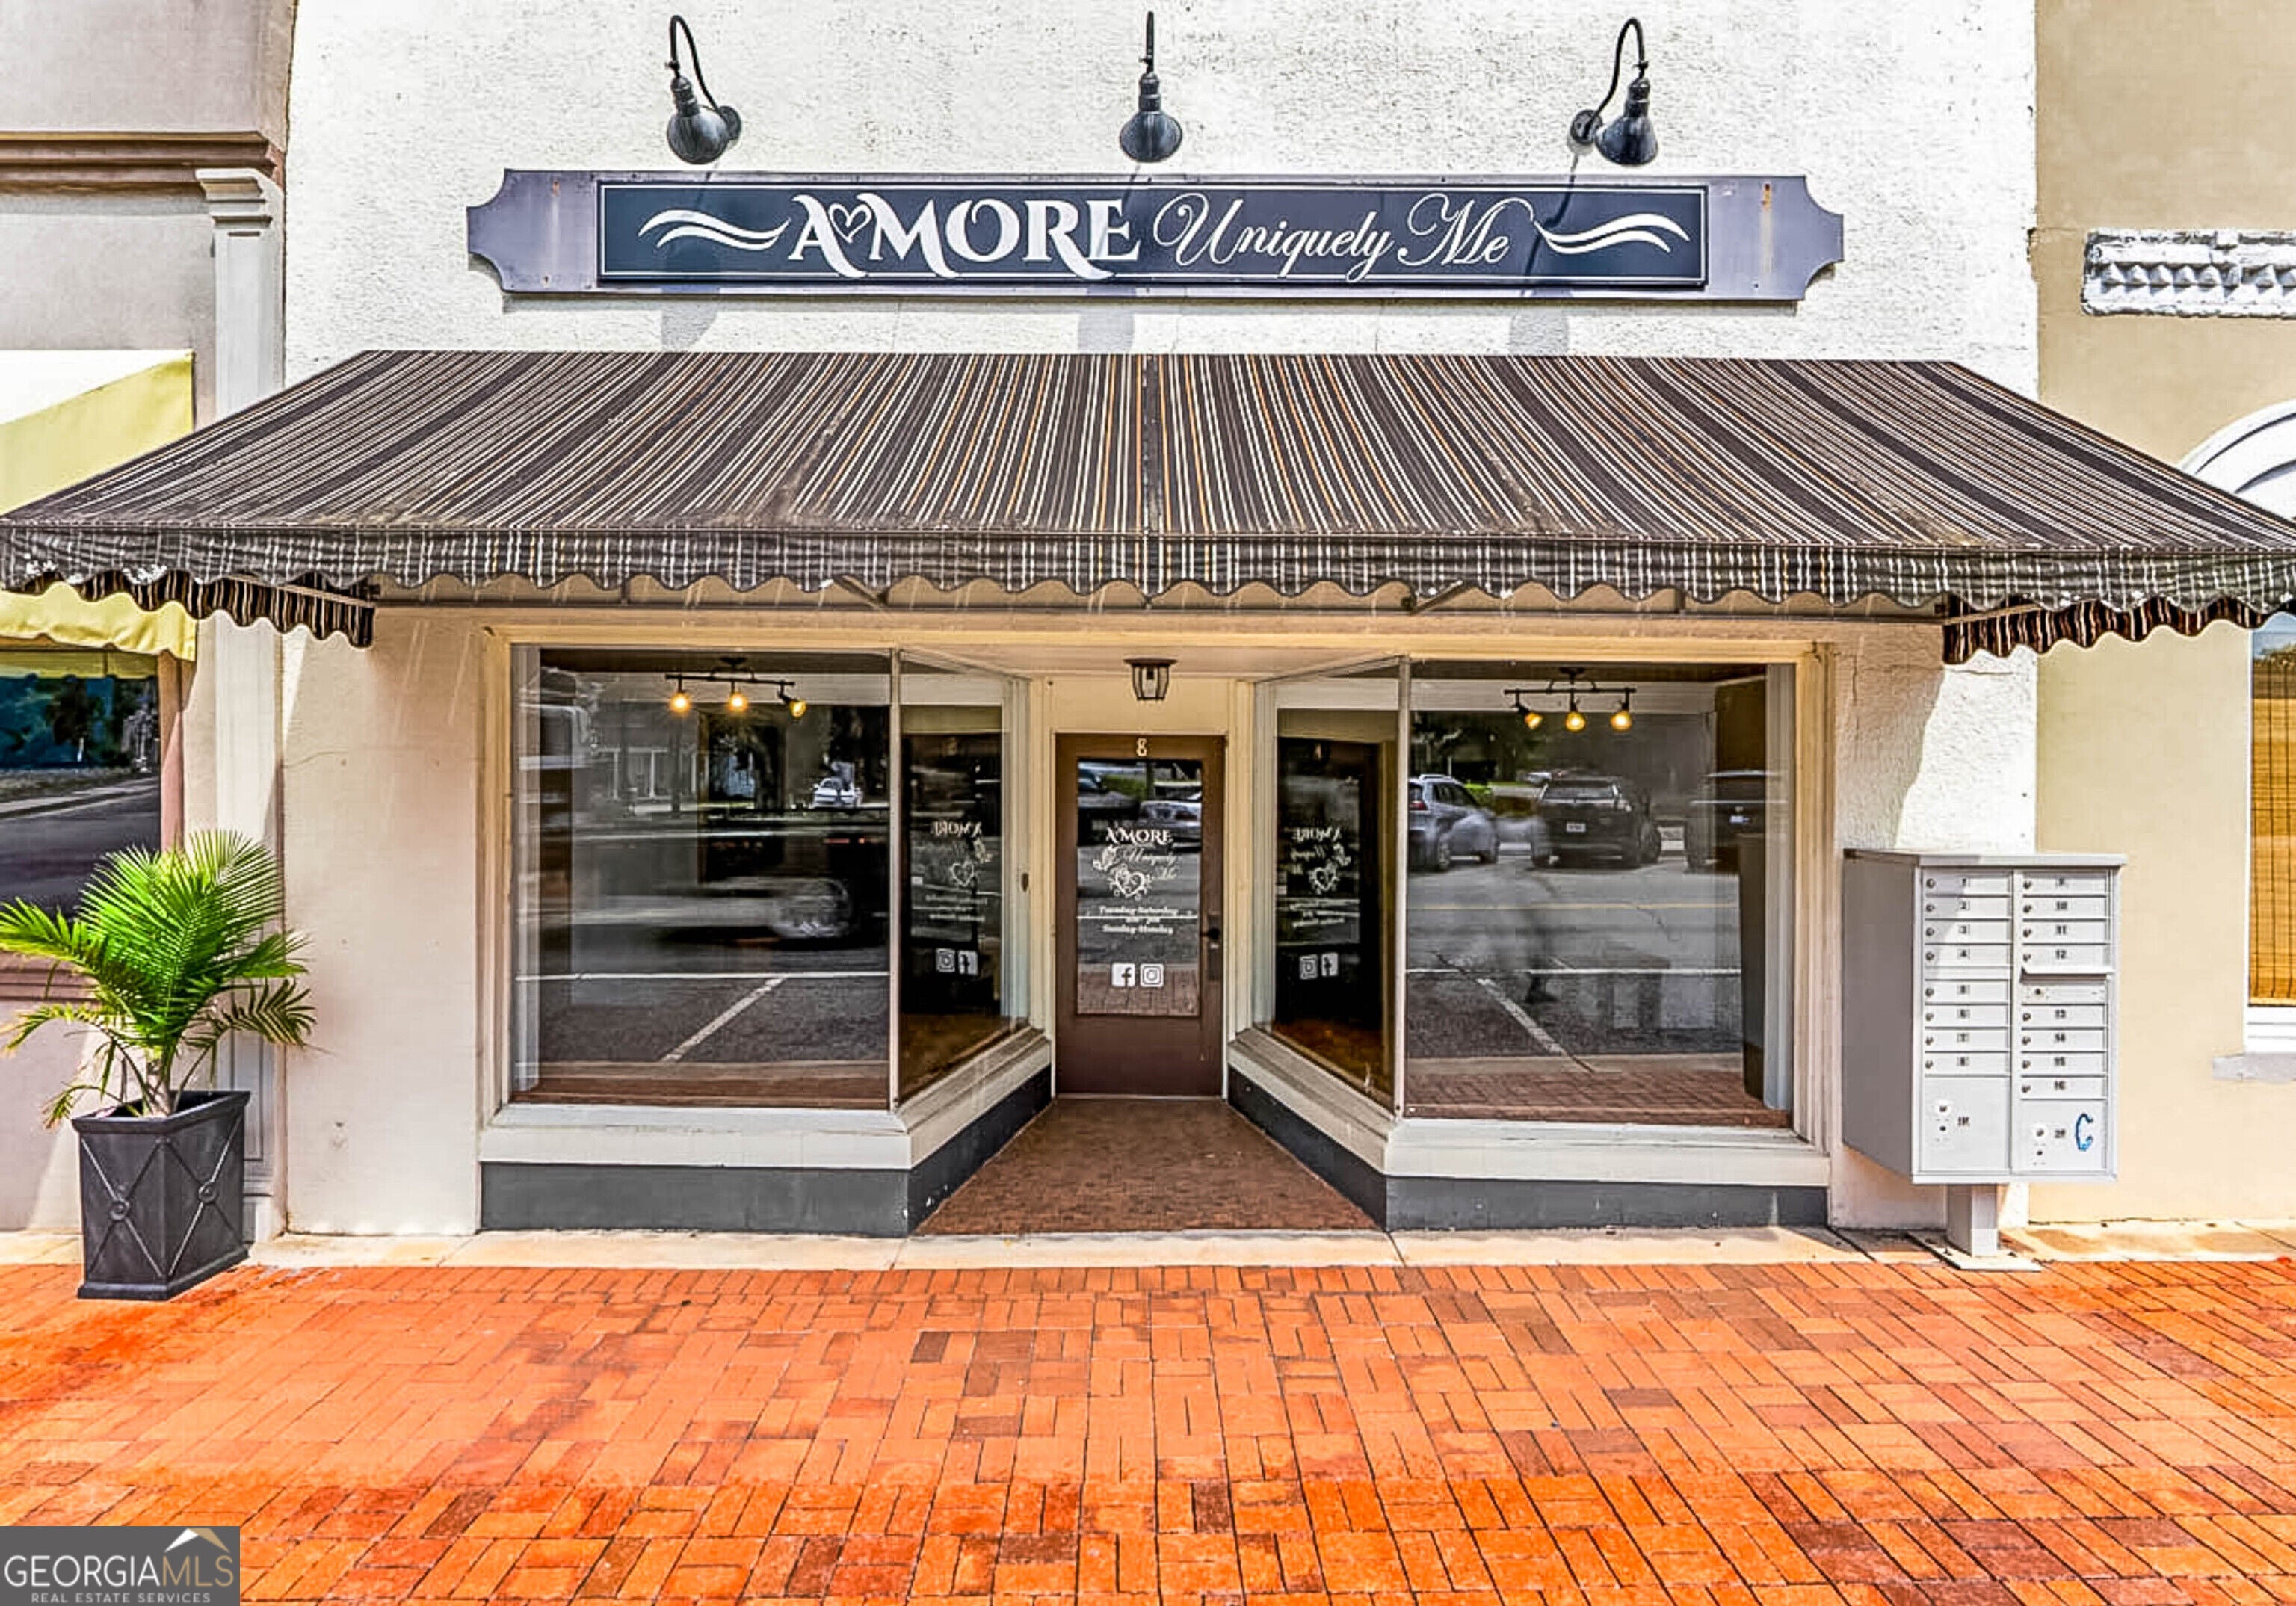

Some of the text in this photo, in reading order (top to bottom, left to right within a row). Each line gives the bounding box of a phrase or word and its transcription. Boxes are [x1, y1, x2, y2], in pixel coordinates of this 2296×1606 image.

[1152, 192, 1395, 282] Uniquely
[1397, 192, 1534, 267] Me
[1136, 738, 1147, 756] 8
[2075, 1113, 2094, 1152] C
